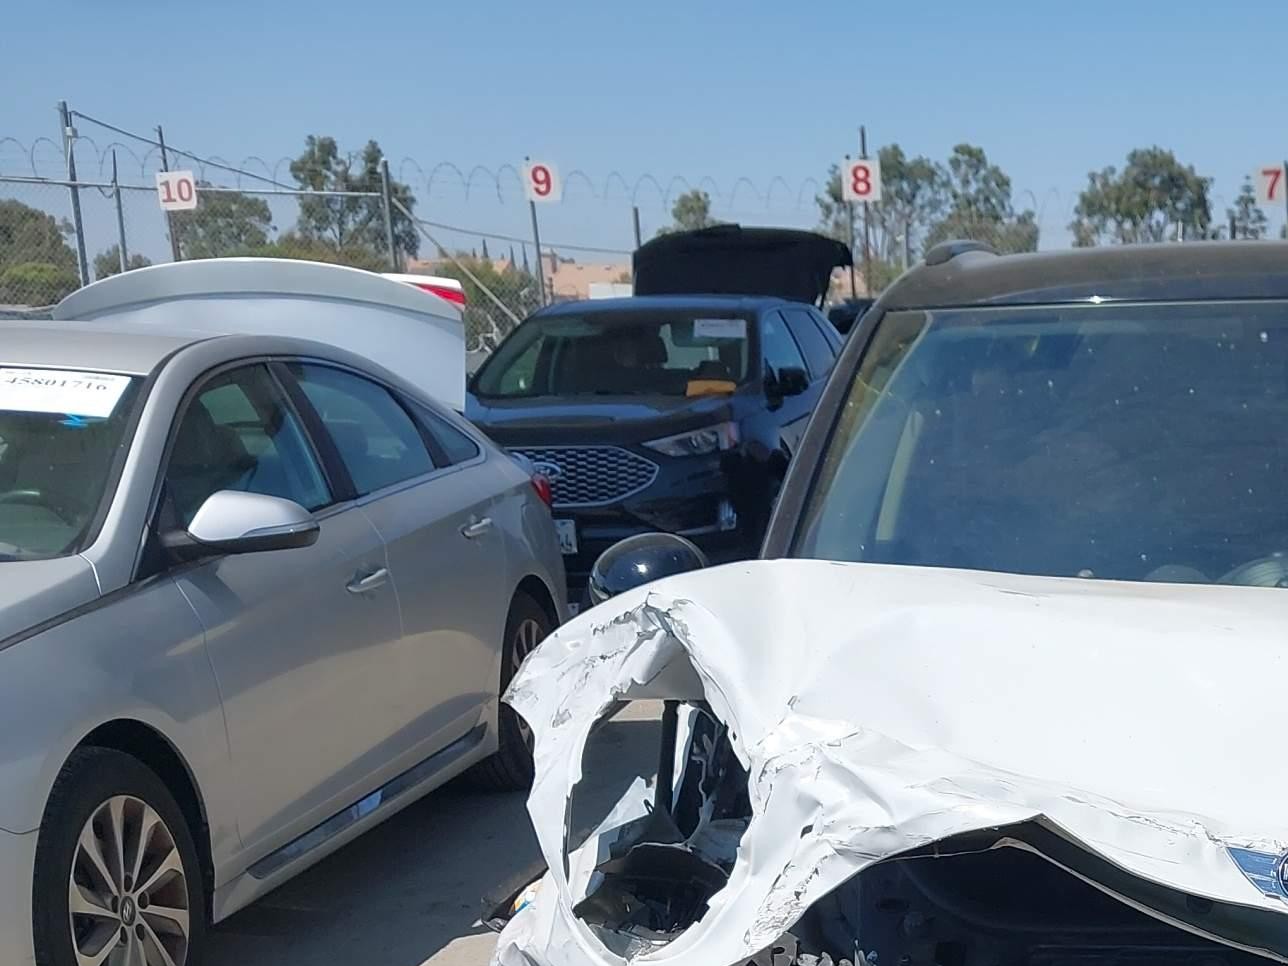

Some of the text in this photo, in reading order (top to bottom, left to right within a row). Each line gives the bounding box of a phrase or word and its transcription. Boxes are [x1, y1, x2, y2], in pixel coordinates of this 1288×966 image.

[159, 178, 193, 203] 10
[531, 165, 552, 197] 9
[852, 165, 871, 196] 8
[1262, 168, 1281, 200] 7
